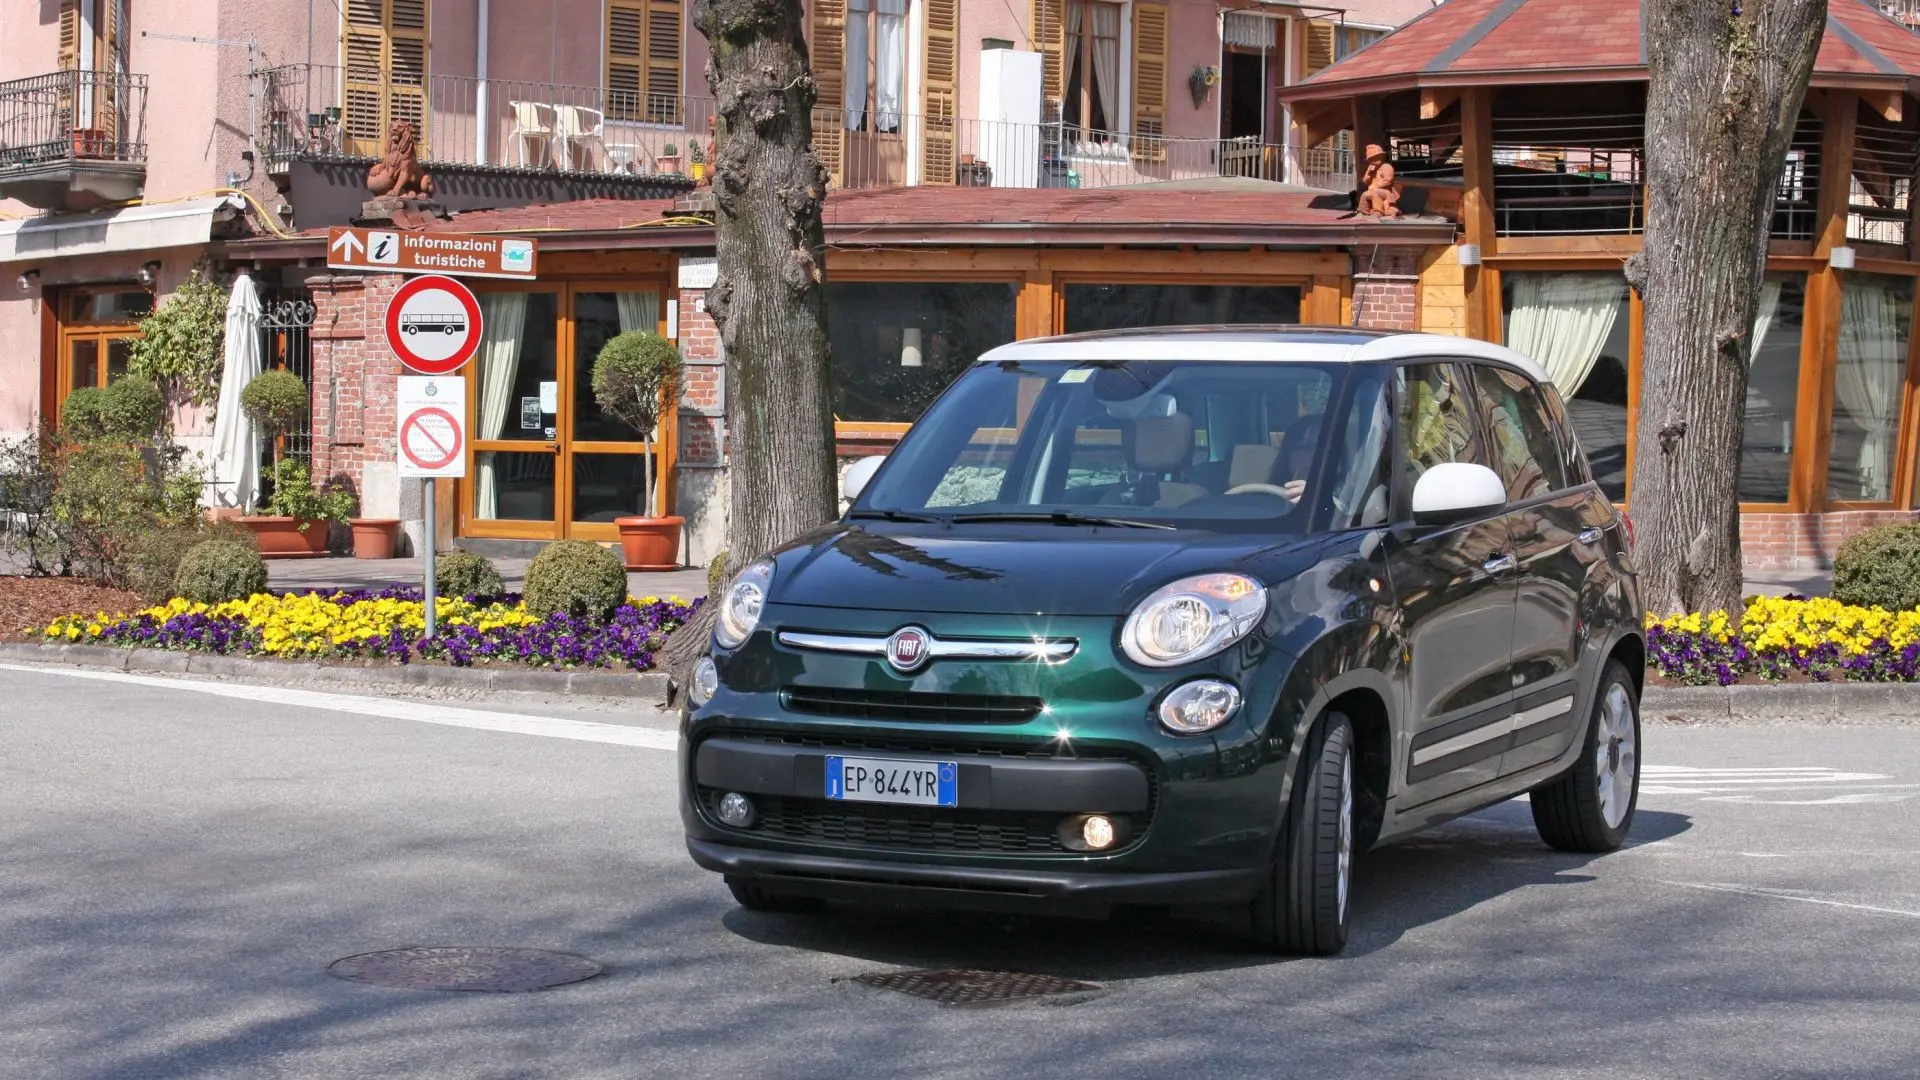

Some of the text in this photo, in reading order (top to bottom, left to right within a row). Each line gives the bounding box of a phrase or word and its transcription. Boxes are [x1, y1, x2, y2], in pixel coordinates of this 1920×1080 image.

[404, 234, 497, 252] informazioni
[414, 252, 486, 268] turistiche
[897, 640, 919, 656] FIAT
